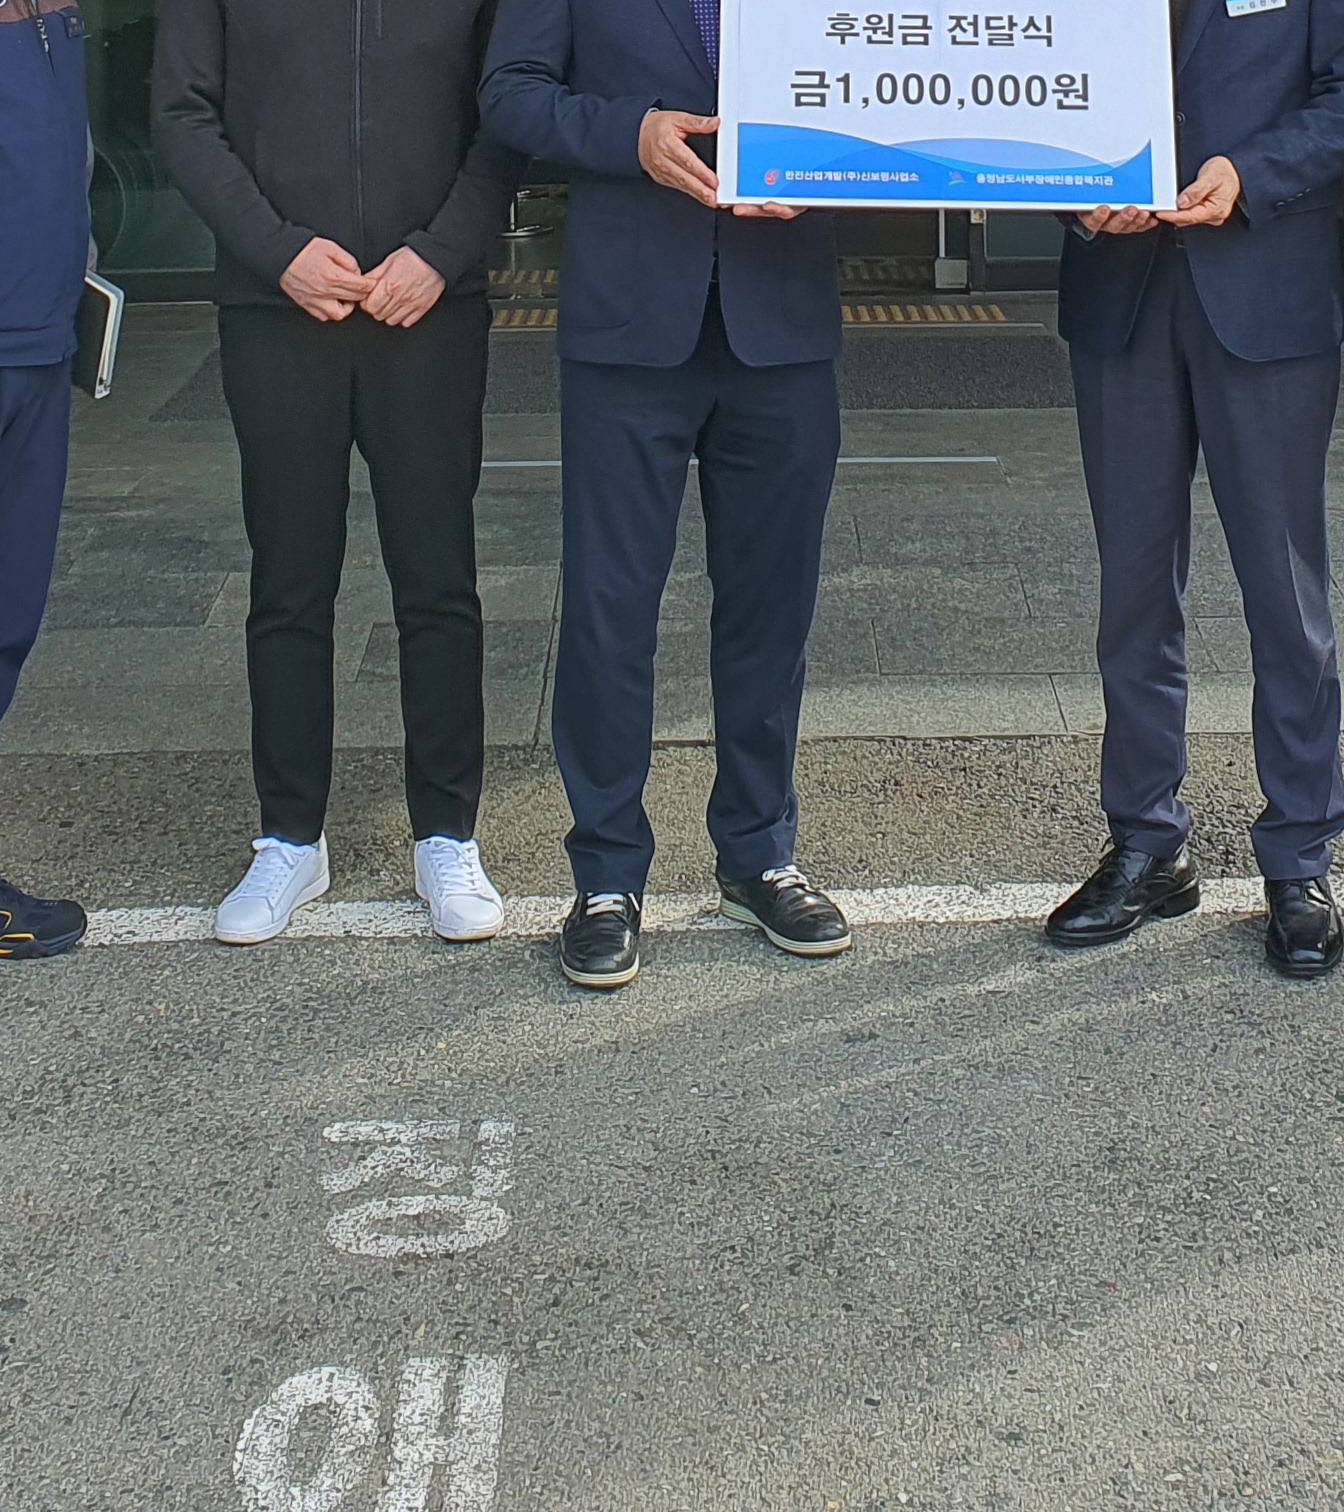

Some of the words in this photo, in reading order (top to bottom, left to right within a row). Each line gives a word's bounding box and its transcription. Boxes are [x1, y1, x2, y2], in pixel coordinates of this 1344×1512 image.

[825, 12, 933, 46] 후원금
[946, 13, 1053, 48] 전달식
[790, 69, 1090, 111] 금1,000,000원
